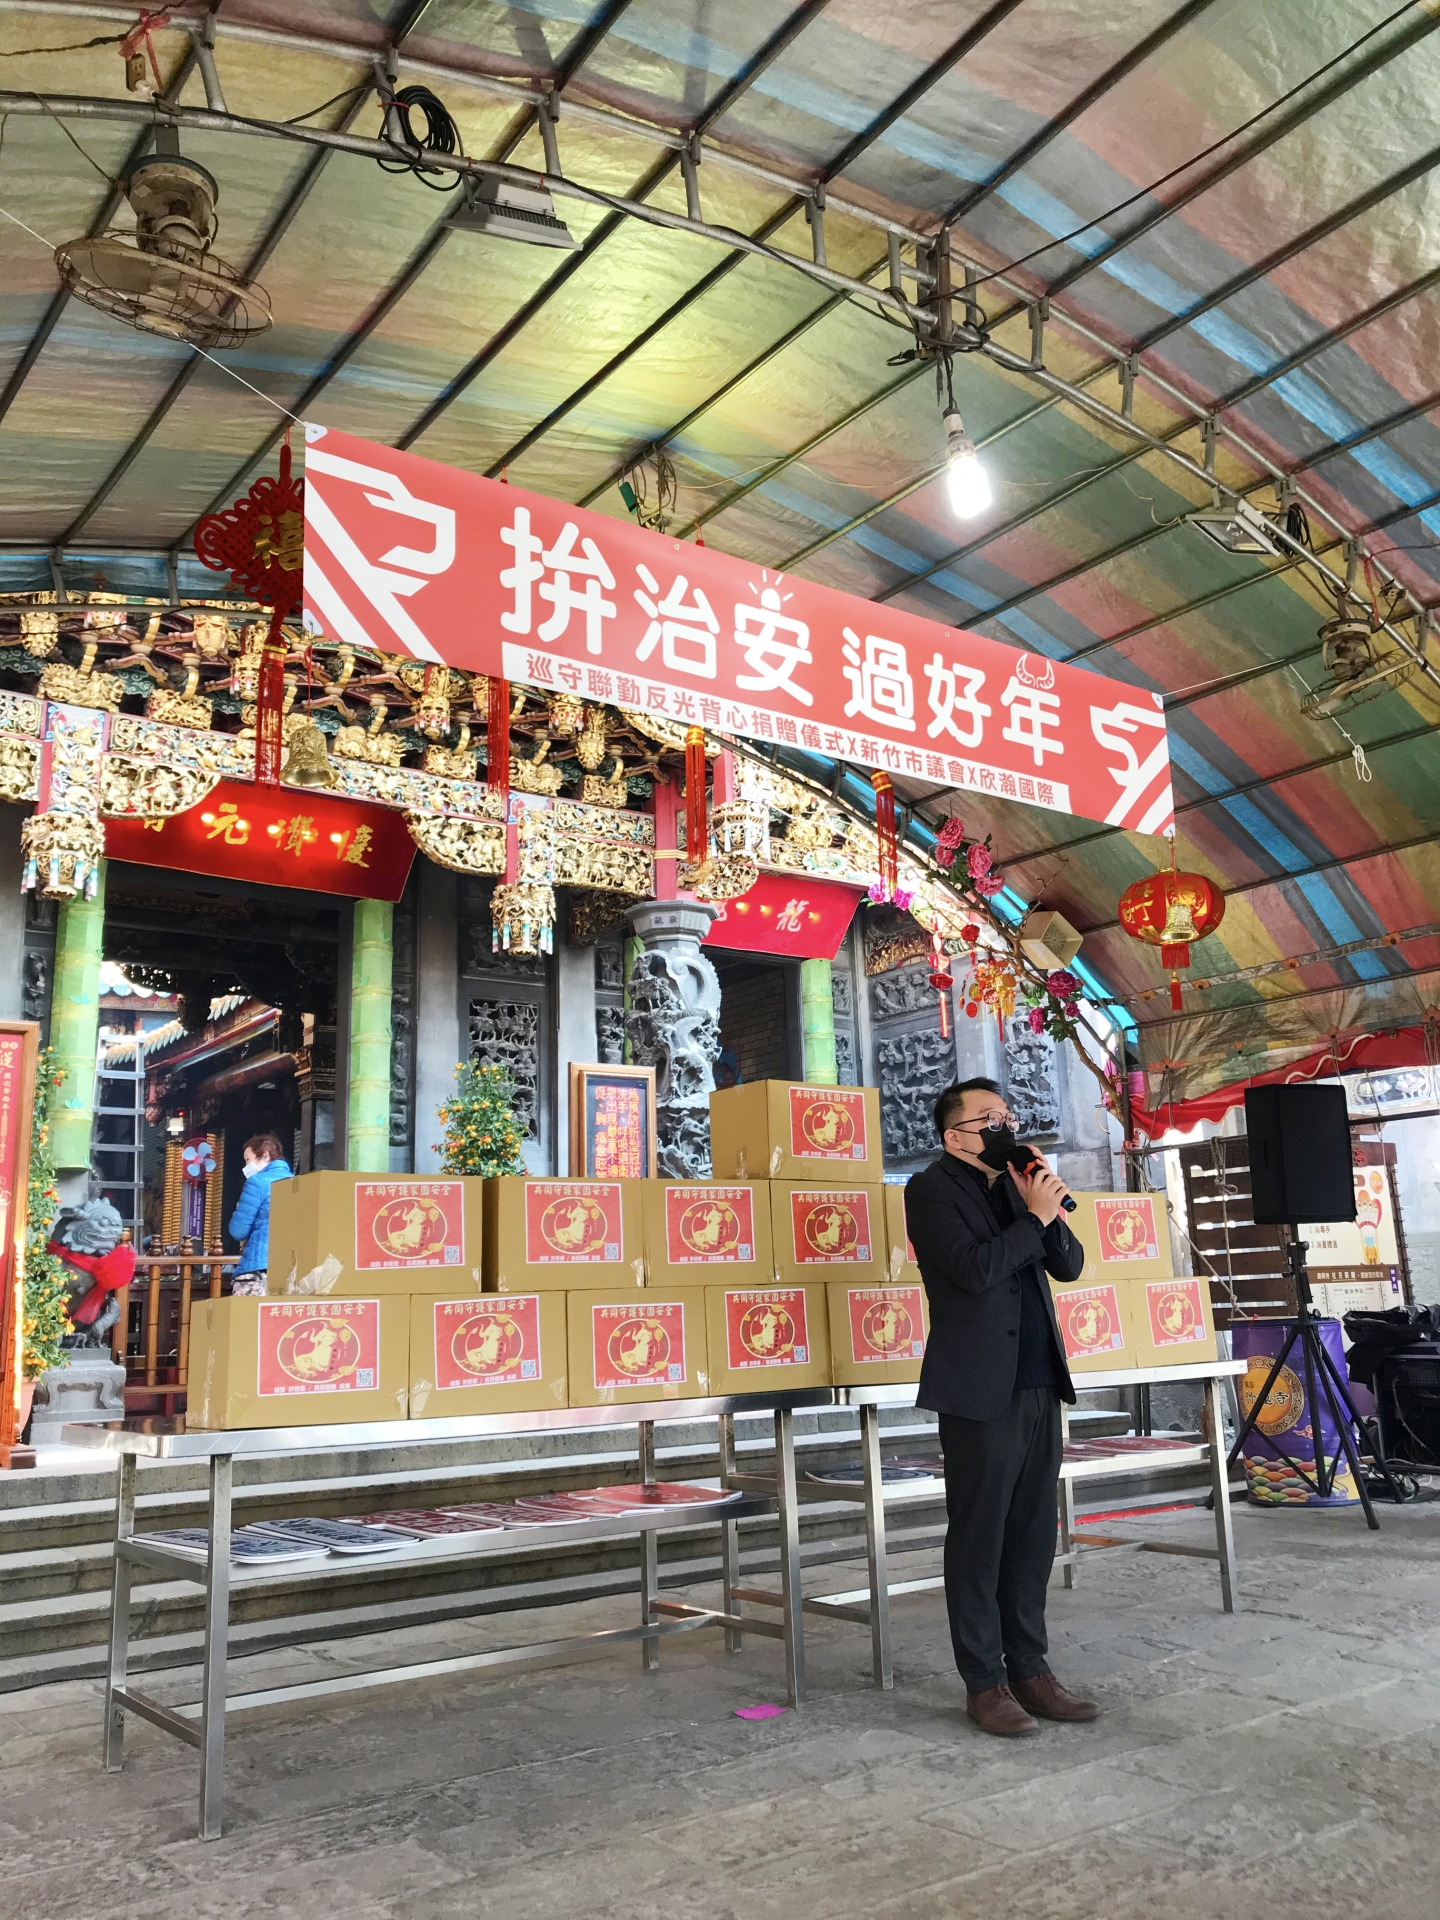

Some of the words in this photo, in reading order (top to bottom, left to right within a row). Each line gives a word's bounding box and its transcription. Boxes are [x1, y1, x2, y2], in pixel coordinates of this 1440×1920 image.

[842, 626, 1064, 766] 過好年
[1244, 1391, 1290, 1405] 竹寺
